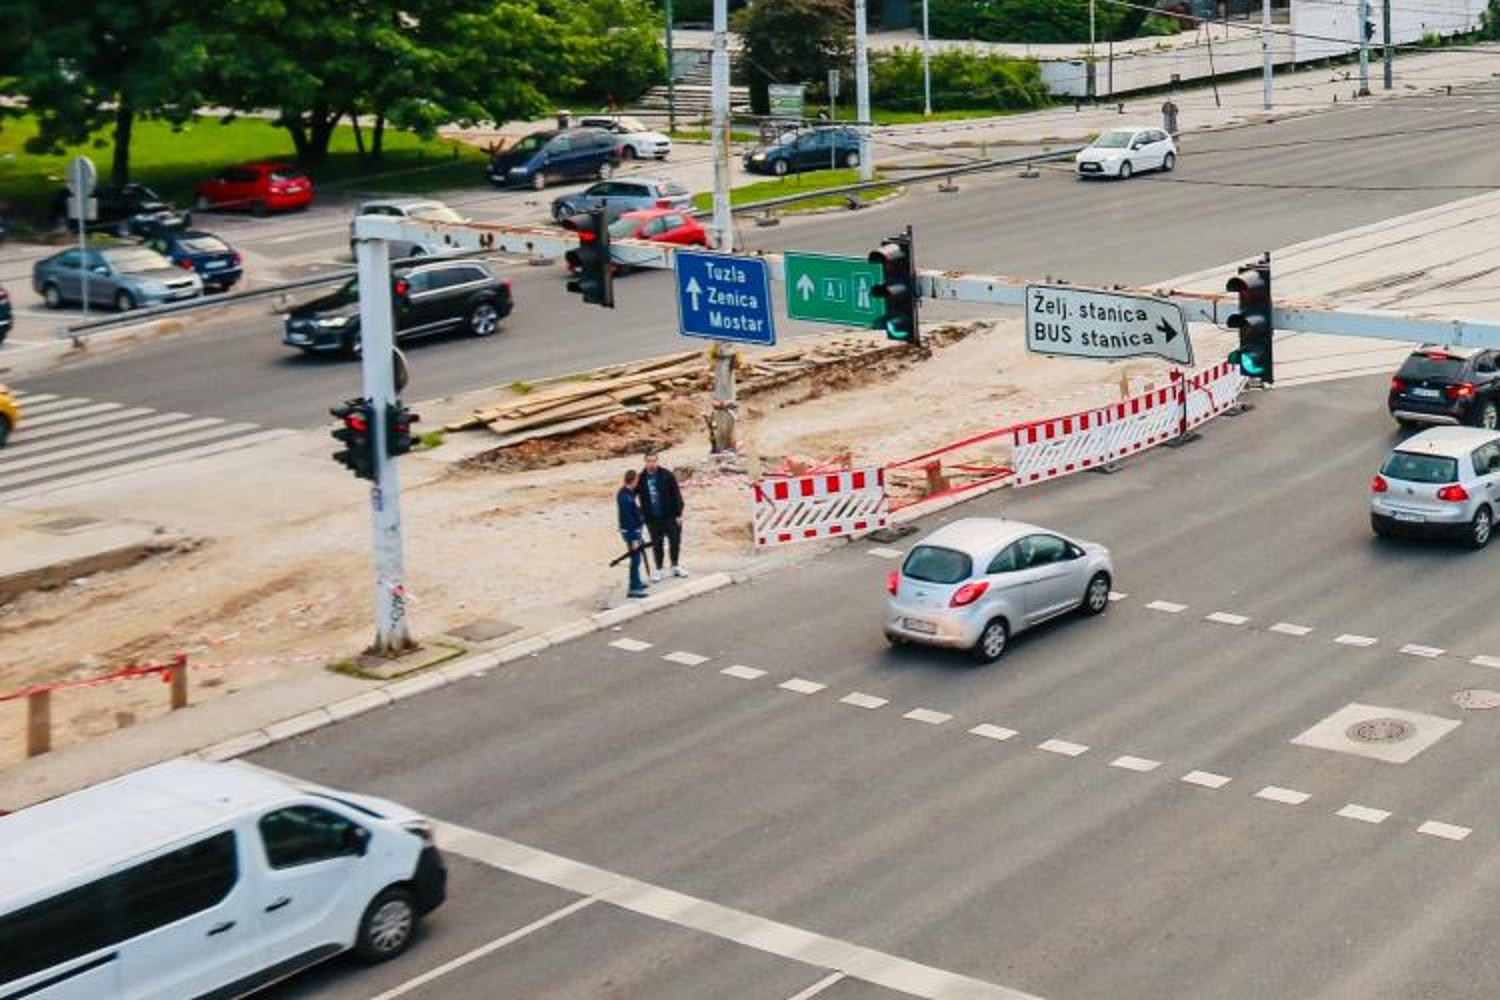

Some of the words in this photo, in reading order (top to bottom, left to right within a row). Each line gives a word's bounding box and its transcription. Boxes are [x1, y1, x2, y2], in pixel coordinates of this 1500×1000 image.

[705, 262, 746, 283] Tuzla
[707, 287, 759, 309] Zenica
[826, 281, 845, 300] A1
[1034, 290, 1073, 321] Želj.
[1079, 302, 1148, 323] stanica
[709, 312, 763, 332] Mostar
[1035, 322, 1073, 343] BUS
[1081, 330, 1154, 349] stanica
